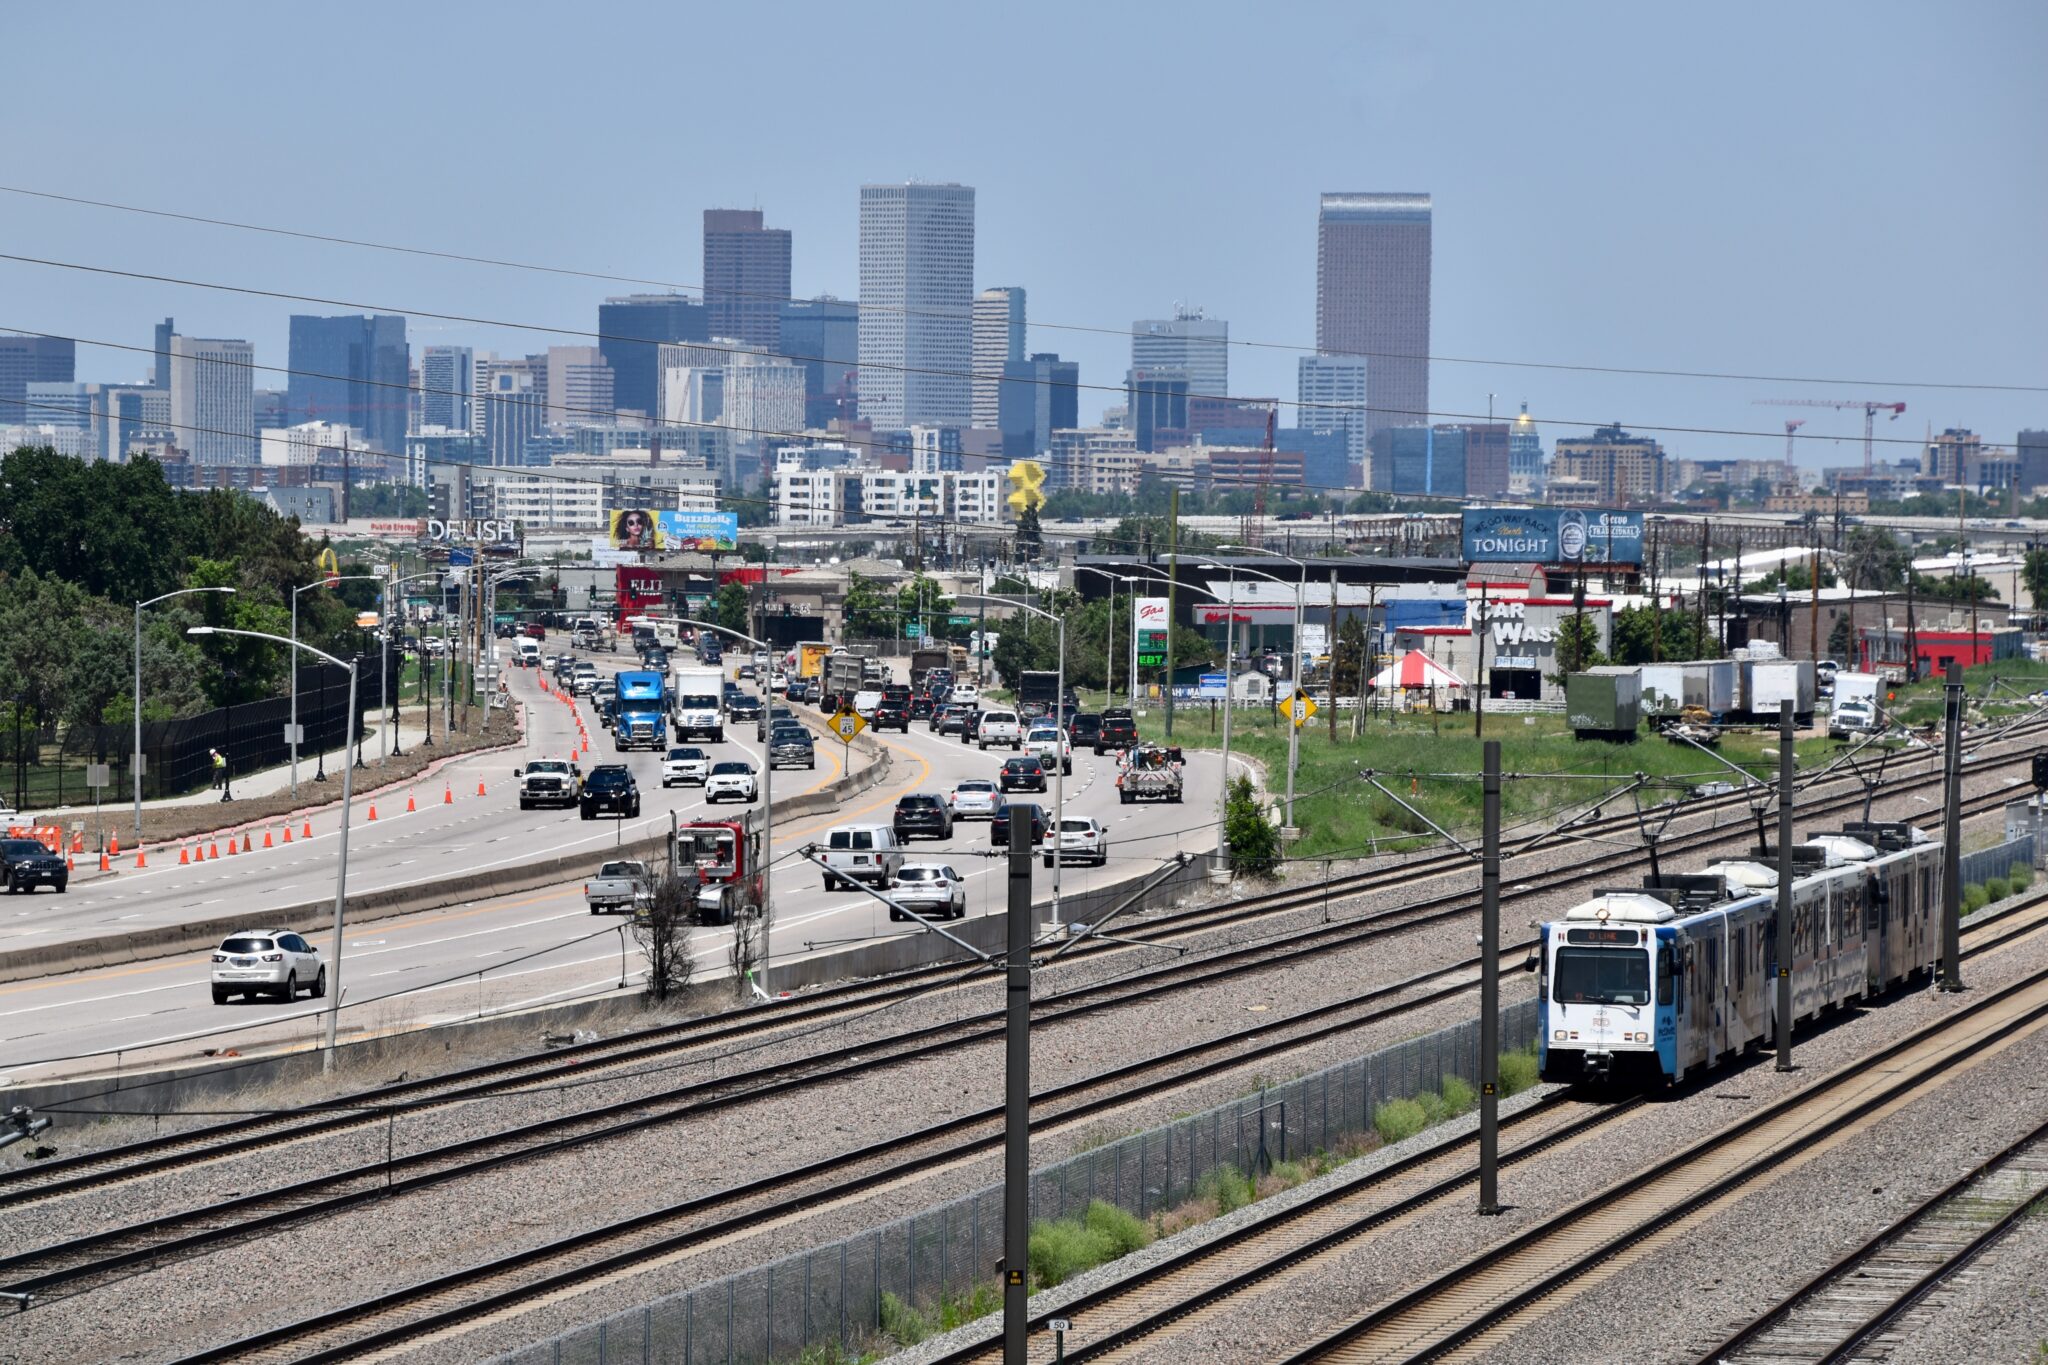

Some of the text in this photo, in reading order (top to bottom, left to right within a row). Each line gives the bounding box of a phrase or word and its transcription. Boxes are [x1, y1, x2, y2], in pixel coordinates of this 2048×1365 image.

[427, 520, 515, 541] DELISH
[1474, 515, 1549, 533] WE GO WAY BACK
[1473, 539, 1548, 552] TONIGHT
[1140, 605, 1164, 619] Gas
[1471, 599, 1525, 620] CAR
[1493, 622, 1563, 645] WAS
[1139, 655, 1162, 664] EBT
[842, 726, 853, 734] 45
[1054, 1321, 1065, 1329] 50
